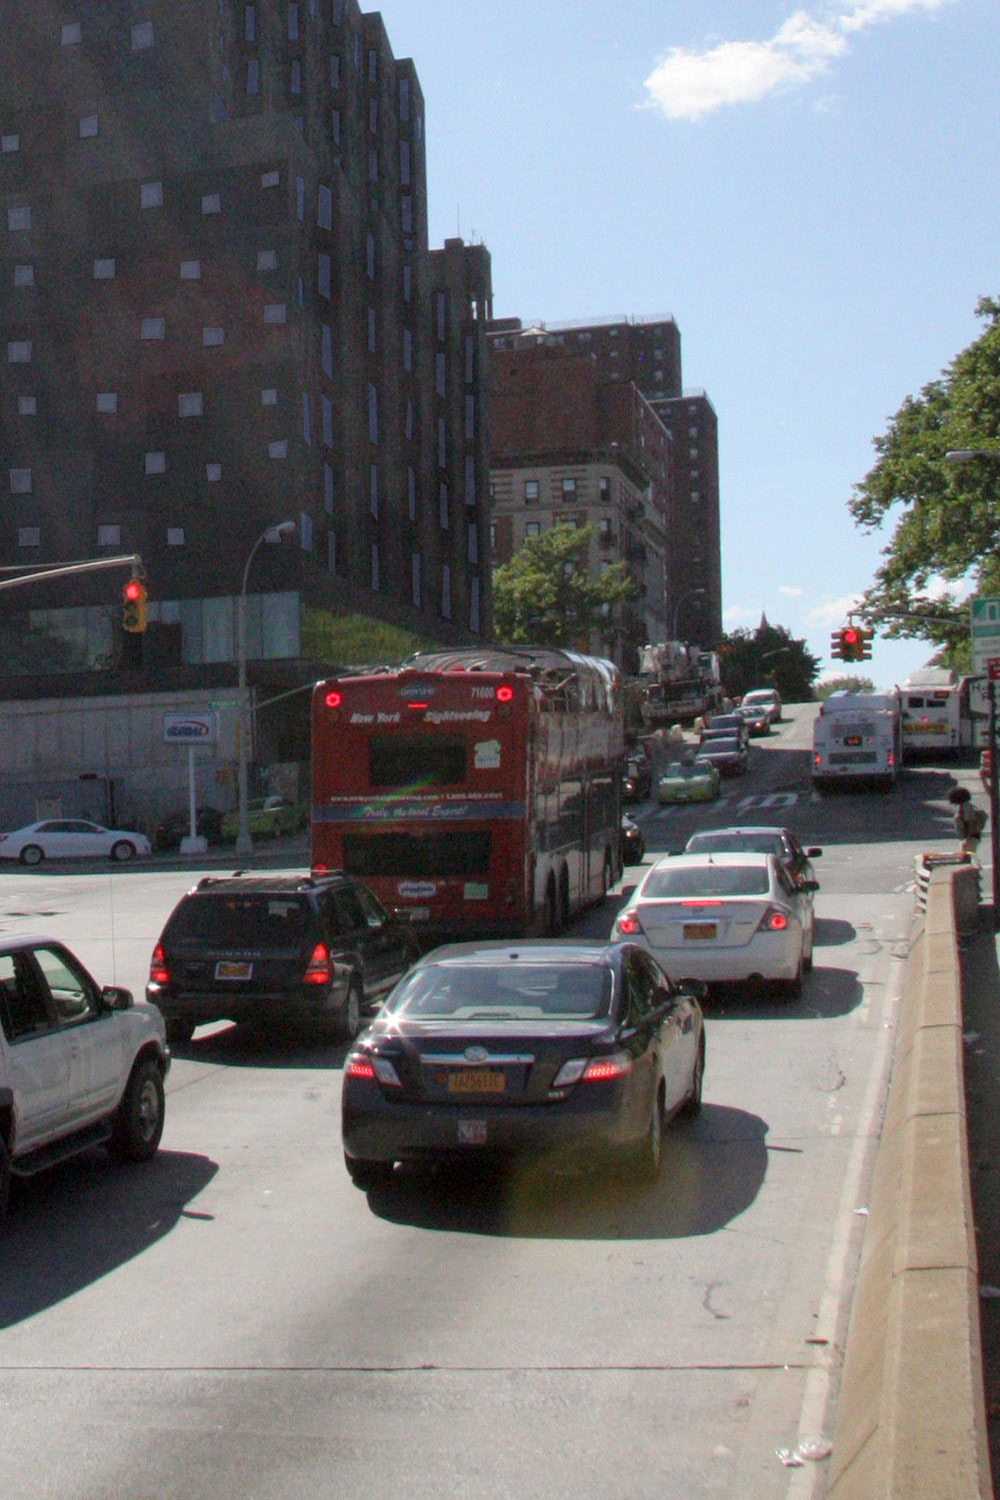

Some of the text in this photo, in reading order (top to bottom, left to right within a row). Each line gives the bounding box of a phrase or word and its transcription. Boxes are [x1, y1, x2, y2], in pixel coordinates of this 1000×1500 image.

[350, 709, 491, 725] New York Sightseeing
